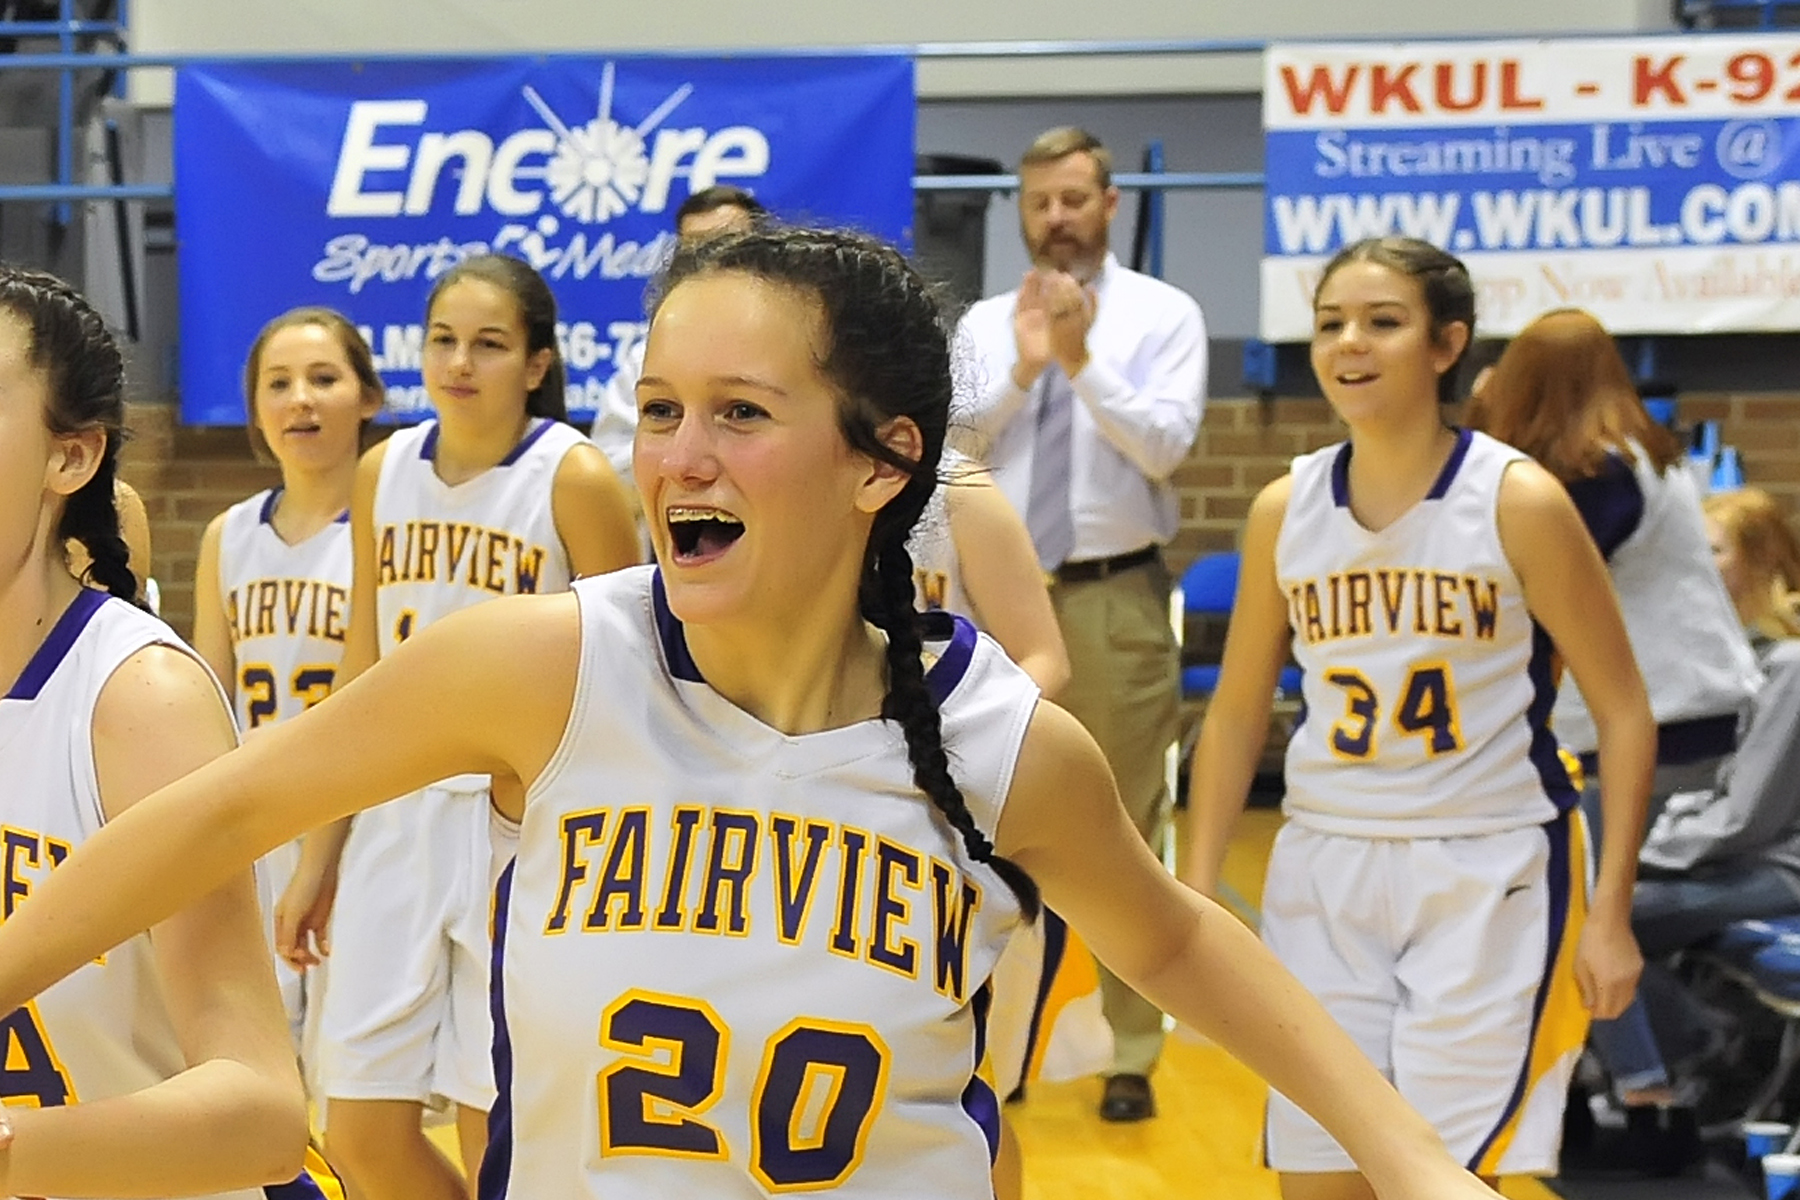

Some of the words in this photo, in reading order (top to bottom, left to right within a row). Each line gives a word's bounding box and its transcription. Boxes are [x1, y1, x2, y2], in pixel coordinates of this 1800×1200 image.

[1280, 58, 1546, 116] WKUL
[1314, 126, 1578, 187] Streaming
[1591, 122, 1704, 170] Live
[1716, 117, 1782, 180] @
[551, 231, 675, 281] Med
[1323, 659, 1466, 763] 34
[542, 804, 985, 1007] FAIRVIEW
[595, 986, 893, 1194] 20
